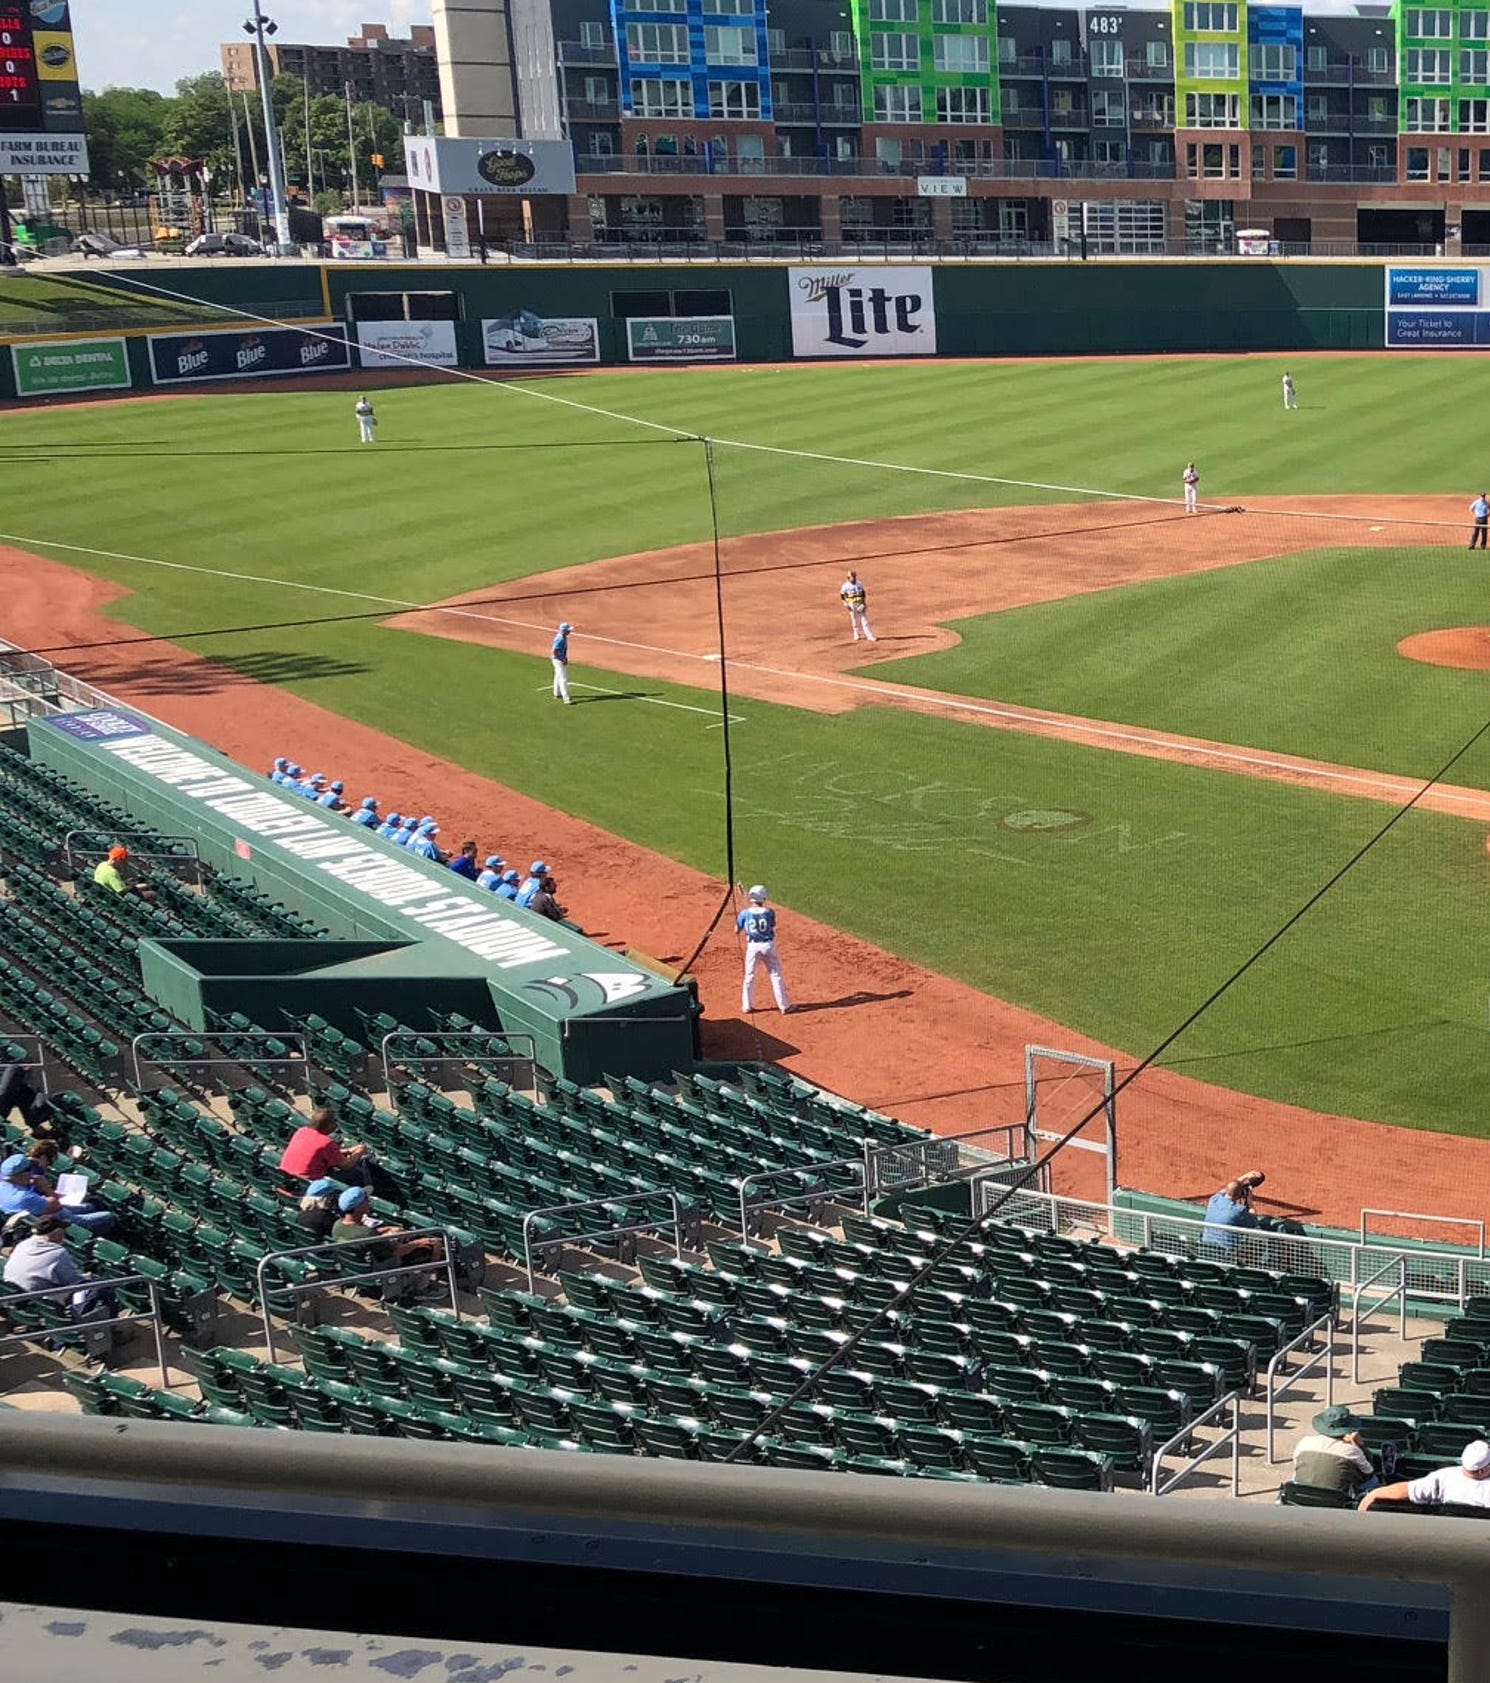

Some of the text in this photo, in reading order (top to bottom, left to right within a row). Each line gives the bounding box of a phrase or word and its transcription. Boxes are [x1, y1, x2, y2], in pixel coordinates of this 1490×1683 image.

[1090, 16, 1123, 34] 483'
[2, 32, 11, 44] 0
[5, 60, 15, 73] 0
[10, 88, 19, 102] 1
[35, 142, 82, 152] BUREAU
[11, 155, 77, 166] INSURANCE
[921, 184, 963, 194] VIEW
[798, 273, 855, 303] Miller
[1418, 283, 1450, 292] AGENCY
[820, 286, 924, 349] Lite
[677, 334, 700, 345] 730
[1422, 329, 1463, 338] Insurance
[236, 345, 266, 369] Blue
[300, 340, 330, 365] Blue
[178, 350, 209, 374] Blue
[98, 733, 231, 785] WELCOME
[175, 775, 257, 799] TO
[272, 827, 374, 862] LAW
[315, 850, 455, 906] SCHOOL
[397, 894, 571, 969] STADIUM
[748, 918, 767, 932] 20
